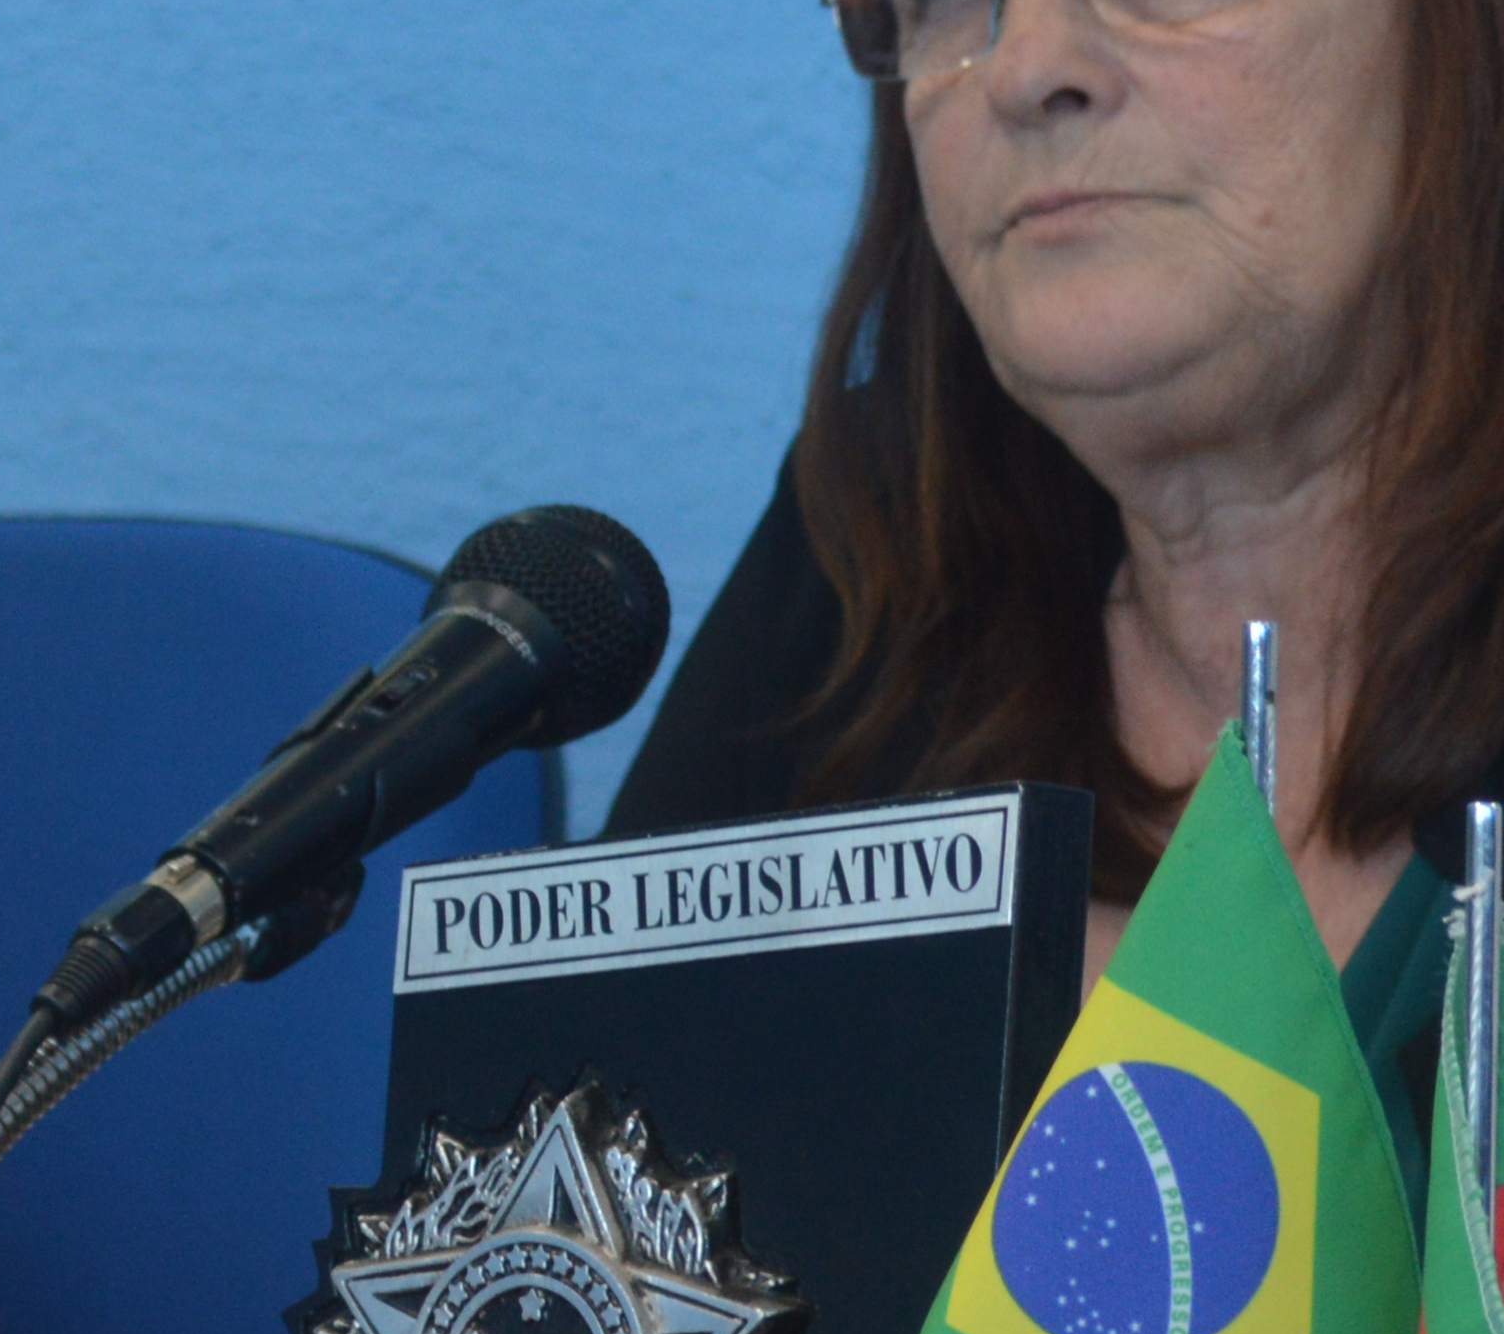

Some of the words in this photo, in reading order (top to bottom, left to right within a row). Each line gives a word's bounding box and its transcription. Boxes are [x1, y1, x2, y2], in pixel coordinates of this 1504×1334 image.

[433, 878, 613, 955] PODER
[632, 831, 984, 931] LEGISLATIVO
[1111, 1071, 1165, 1155] ORDEM
[1155, 1165, 1172, 1178] E
